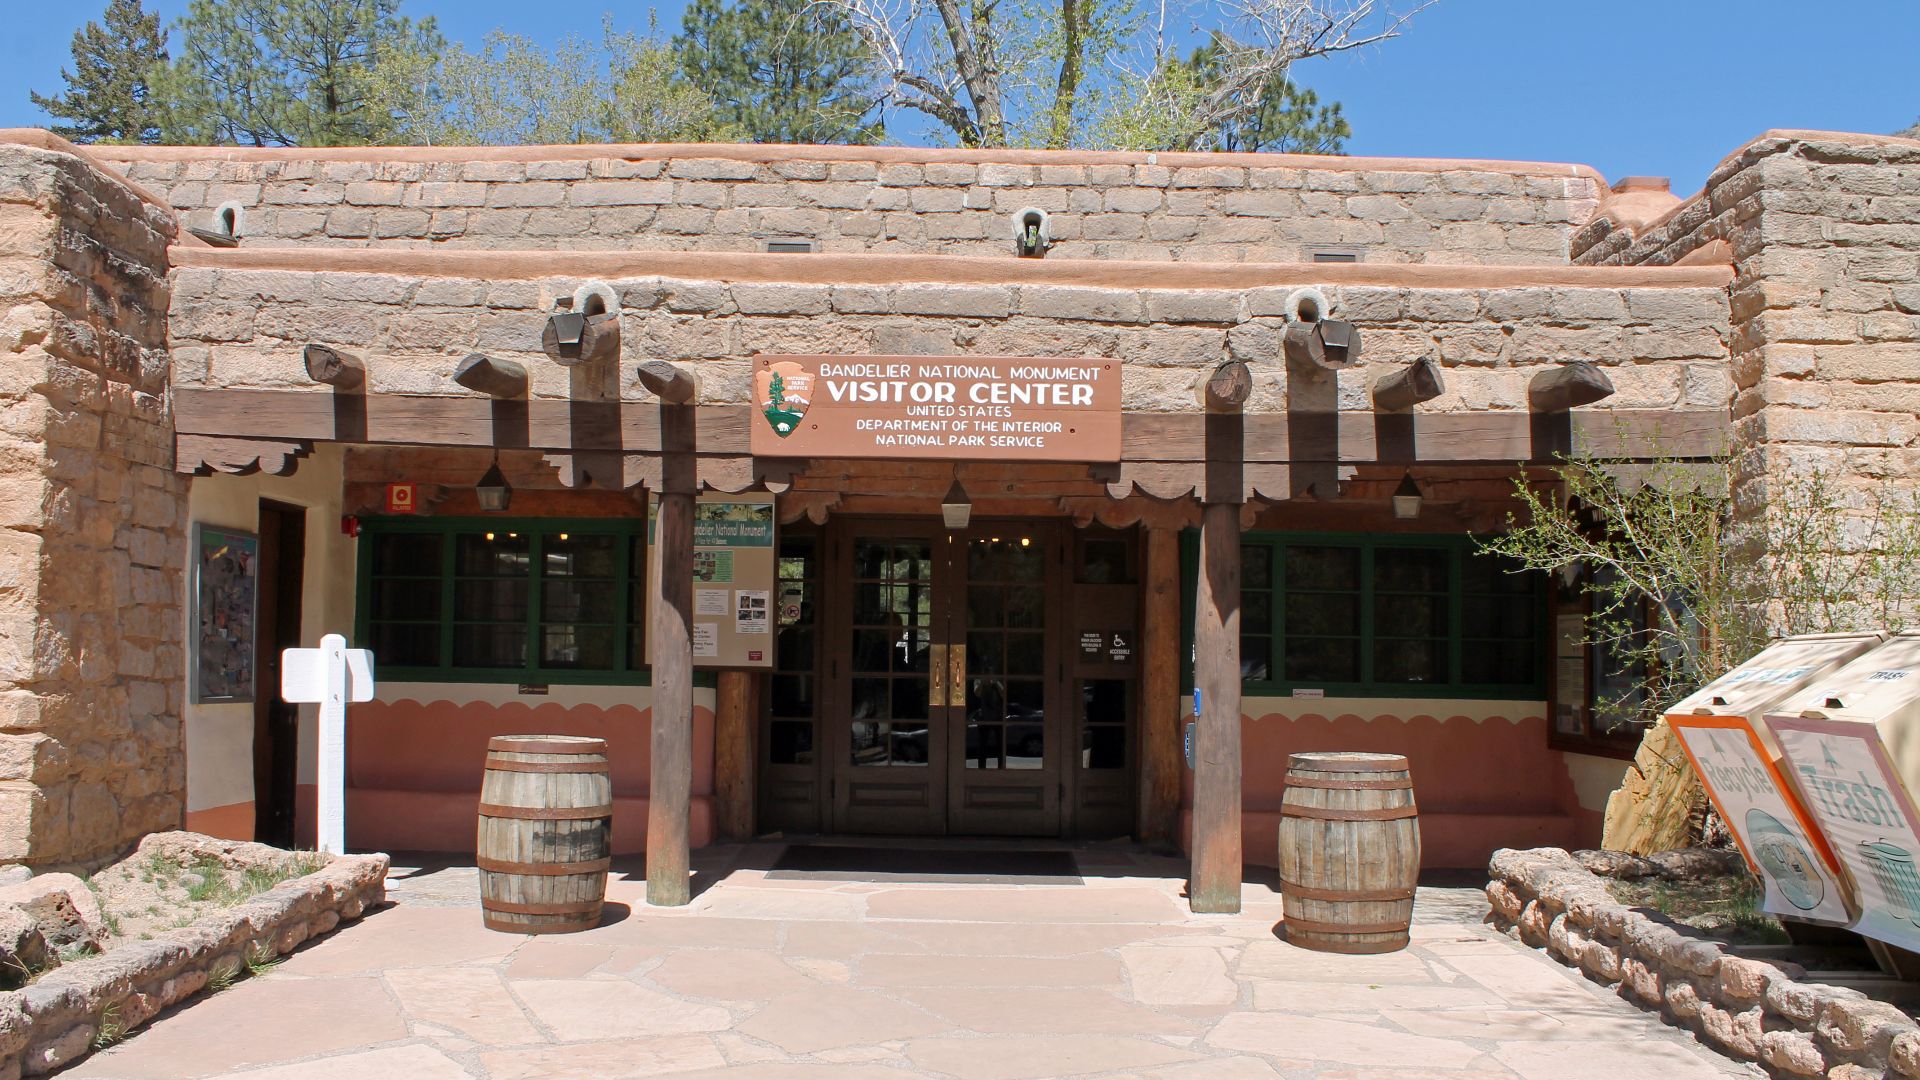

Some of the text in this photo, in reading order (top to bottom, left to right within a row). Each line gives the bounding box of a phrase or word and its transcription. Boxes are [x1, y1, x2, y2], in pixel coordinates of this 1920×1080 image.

[820, 363, 1101, 381] BANDELIER NATIONAL MONUMENT
[826, 381, 1095, 406] VISITOR CENTER
[907, 405, 1012, 418] UNITED STATES
[856, 419, 1062, 433] DEPARTMENT OF THE INTERIOR
[876, 434, 1045, 448] NATIONAL PARK SERVICE
[715, 523, 739, 536] National
[740, 523, 767, 537] Monument
[1868, 671, 1909, 680] TRASH
[1698, 756, 1774, 803] Recycle
[1798, 765, 1905, 828] Trash
